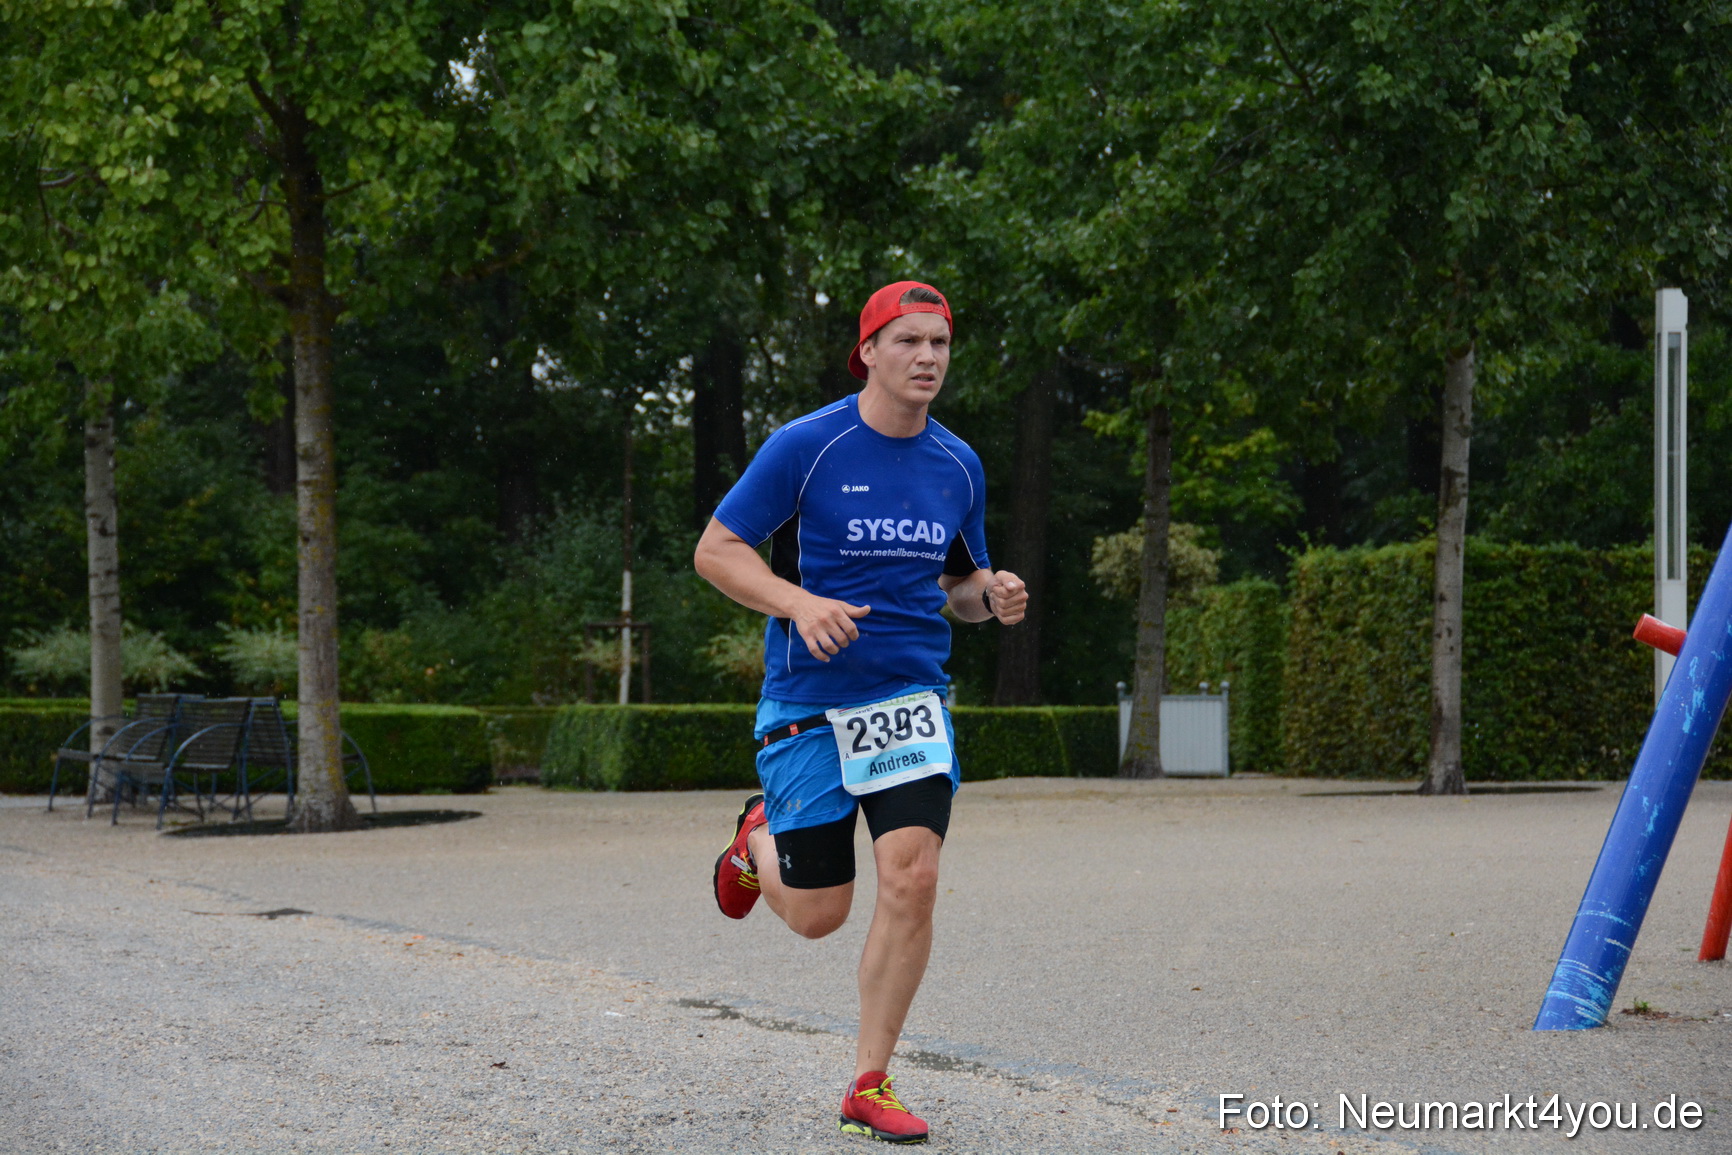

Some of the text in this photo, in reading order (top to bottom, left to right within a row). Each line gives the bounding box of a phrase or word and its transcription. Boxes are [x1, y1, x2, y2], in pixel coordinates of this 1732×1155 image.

[847, 518, 946, 545] SYSCAD
[847, 704, 936, 753] 2393
[869, 750, 926, 776] Andreas
